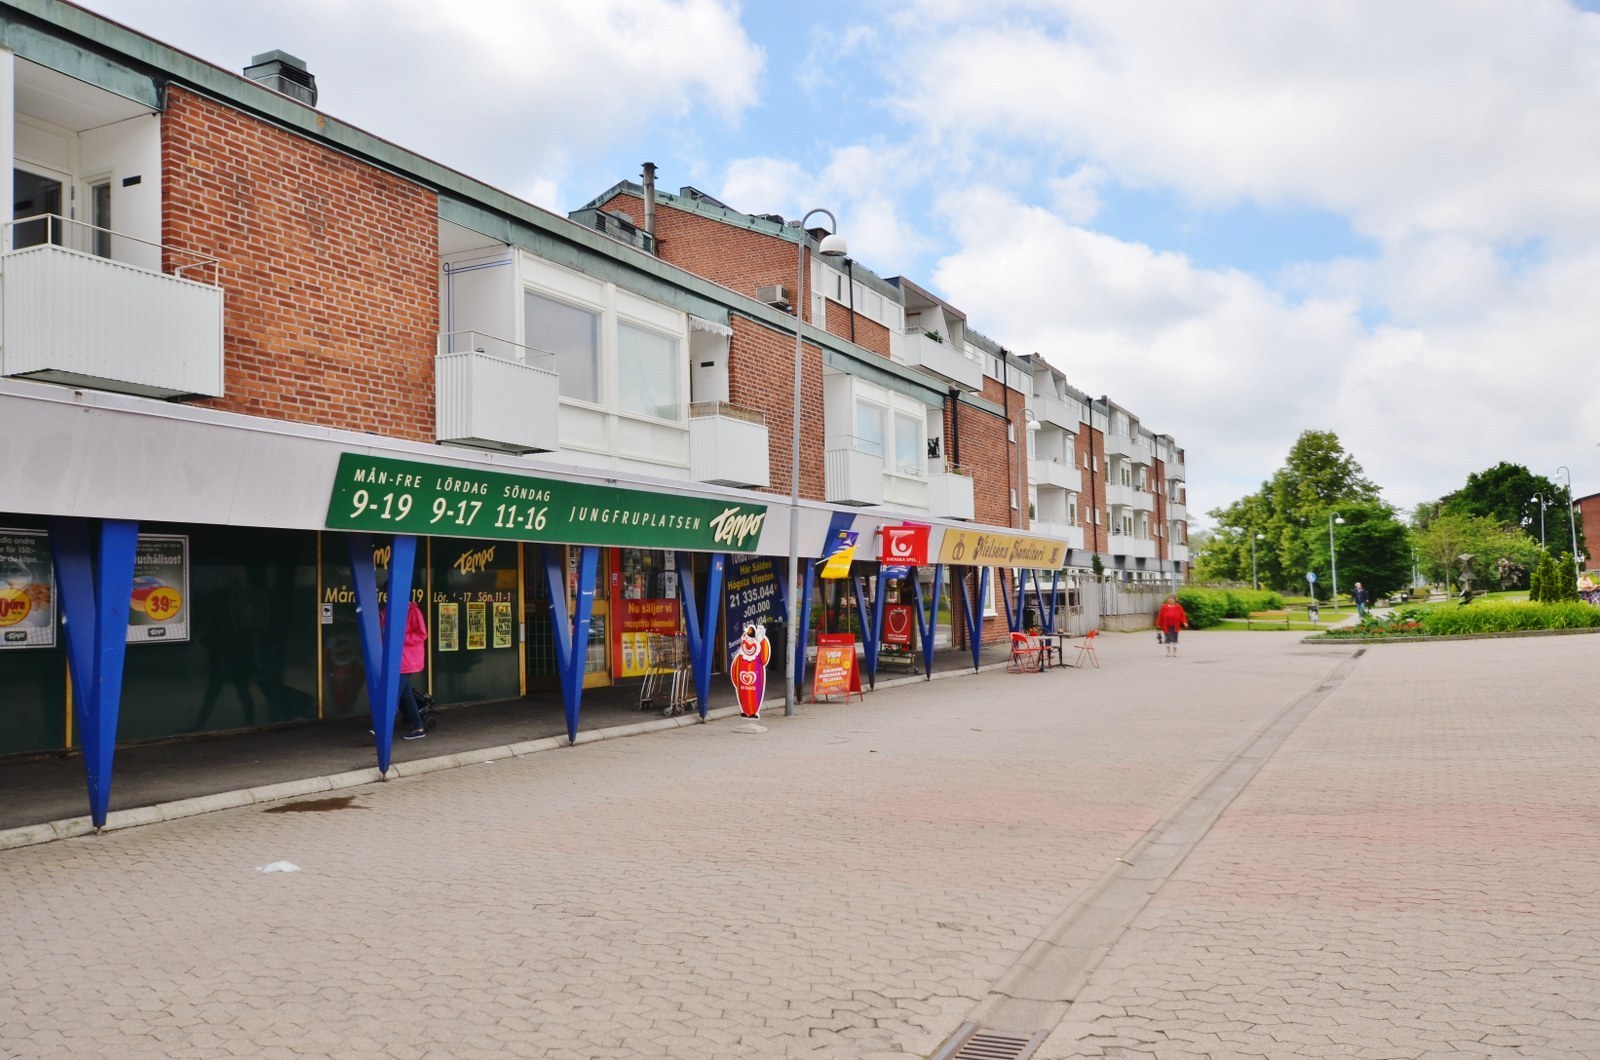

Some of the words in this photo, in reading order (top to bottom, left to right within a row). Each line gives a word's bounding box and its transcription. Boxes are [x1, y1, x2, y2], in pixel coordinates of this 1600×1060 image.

[353, 467, 422, 488] MÅN-FRE
[436, 477, 488, 495] LÖRDAG
[503, 486, 551, 502] SÖNDAG
[350, 489, 413, 522] 9-19
[430, 497, 482, 526] 9-17
[494, 503, 548, 531] 11-16
[569, 506, 700, 530] JUNGFRUPLATSEN
[709, 507, 765, 547] Tempo
[454, 545, 495, 575] Tempo
[628, 602, 640, 613] Nu
[641, 602, 664, 616] säljer
[664, 602, 673, 613] vi
[730, 593, 740, 608] 21
[742, 583, 775, 604] 335.044
